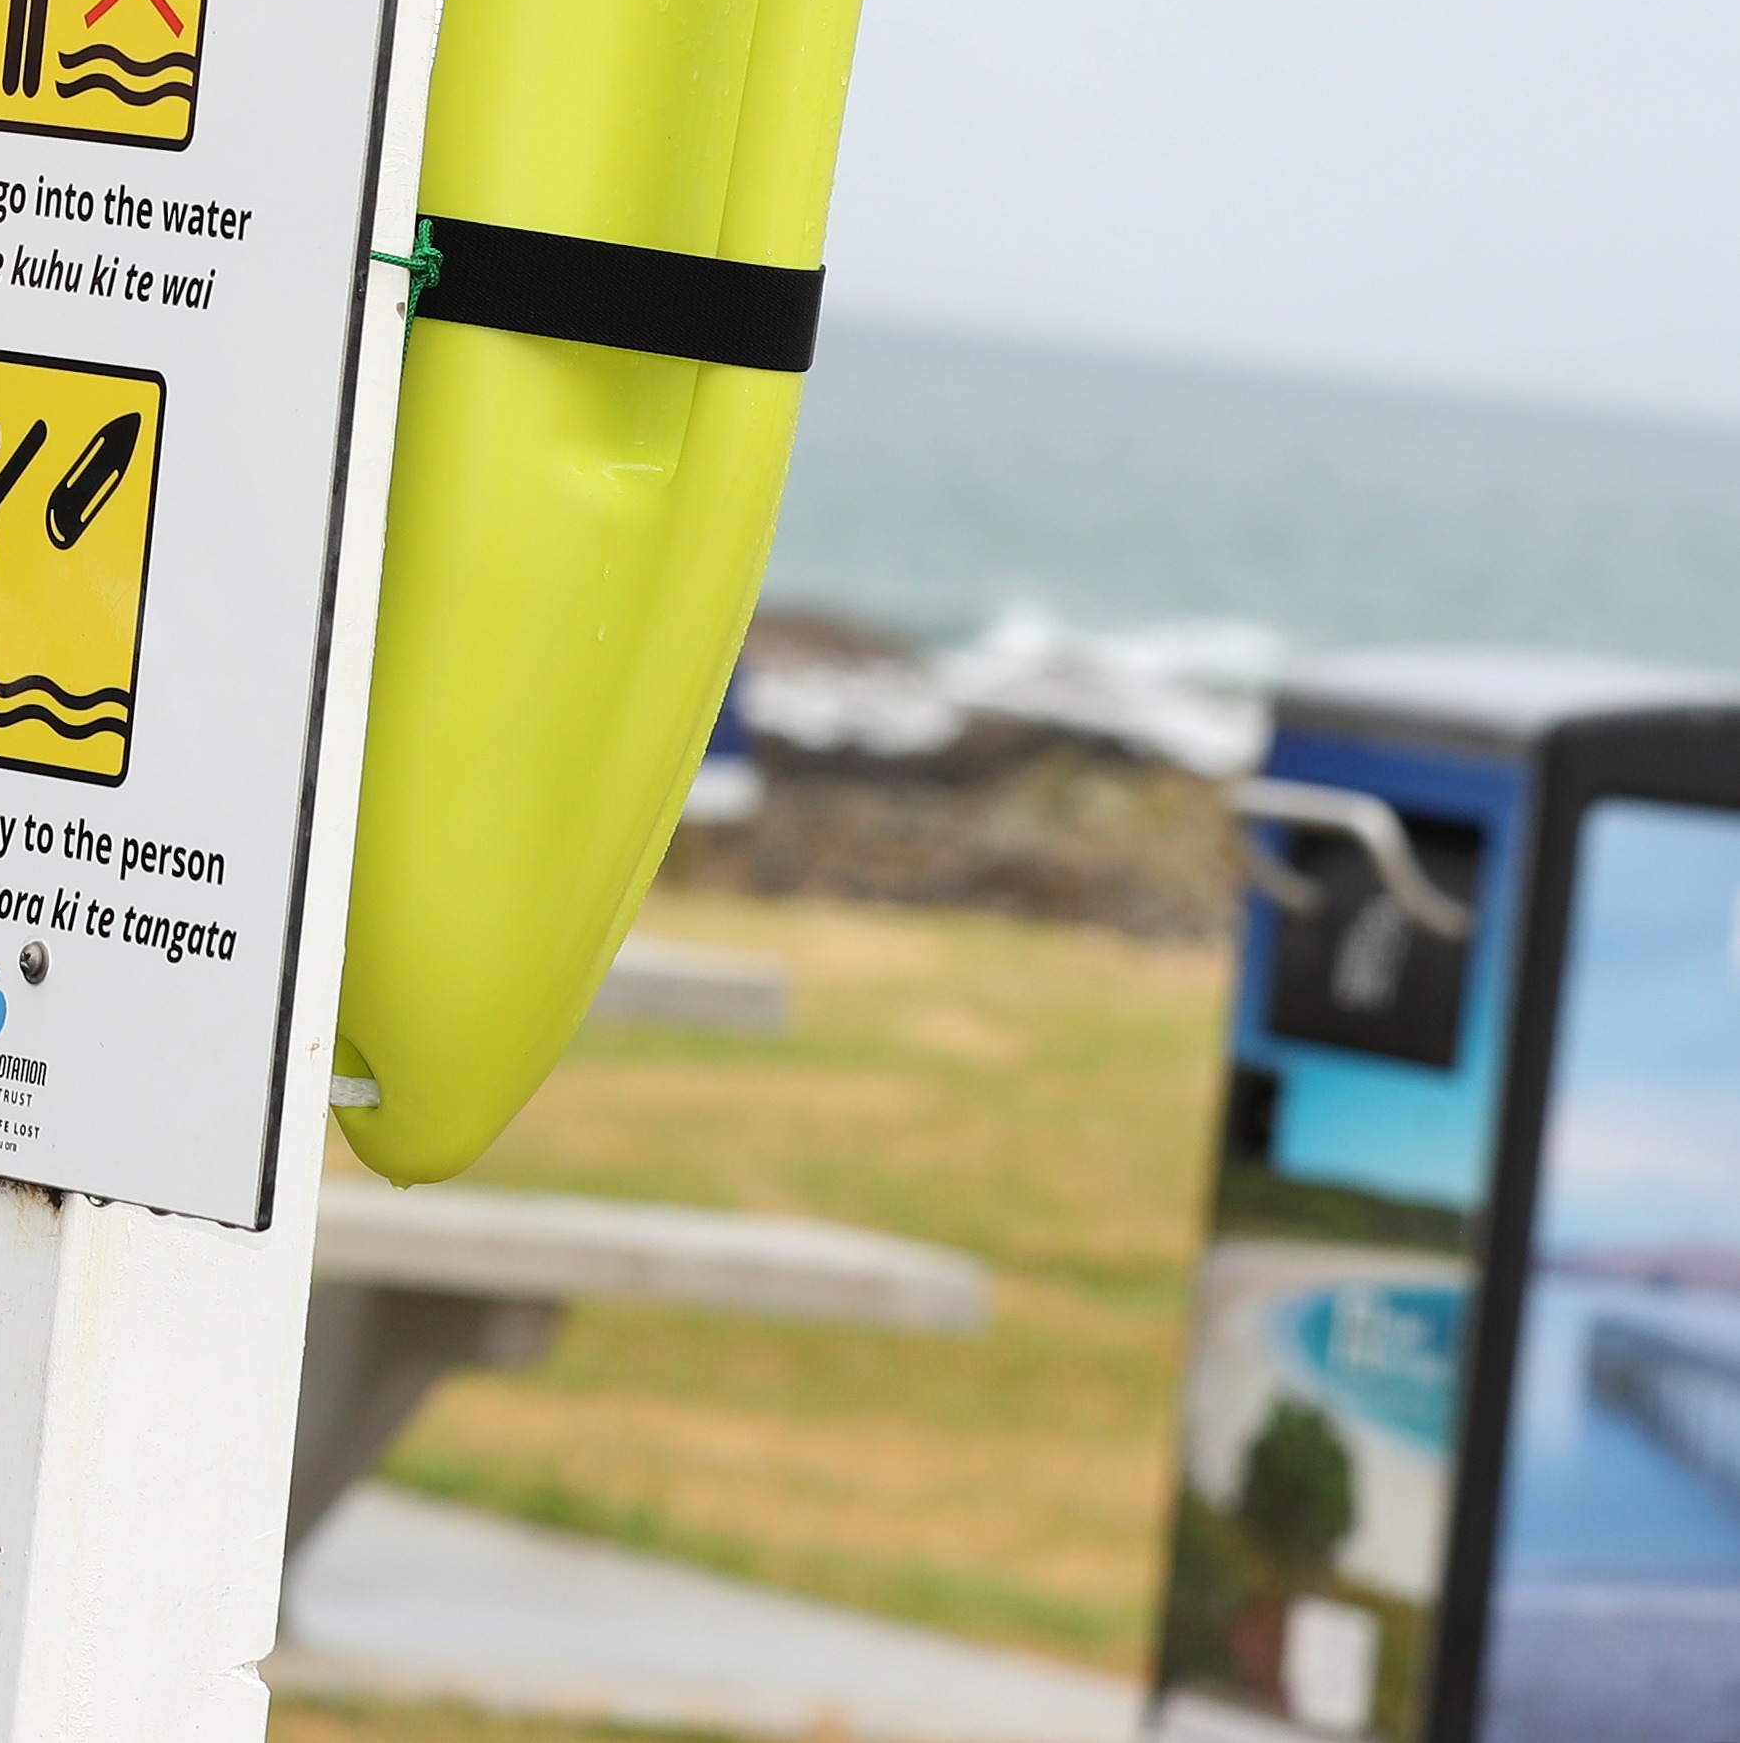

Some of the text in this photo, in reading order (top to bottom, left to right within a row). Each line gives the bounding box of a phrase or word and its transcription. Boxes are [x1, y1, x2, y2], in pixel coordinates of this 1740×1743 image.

[35, 174, 94, 223] into
[103, 184, 153, 230] the
[162, 200, 253, 241] water
[10, 244, 84, 293] kuhu
[88, 254, 120, 298] ki
[124, 263, 154, 303] te
[162, 268, 216, 310] wai
[24, 814, 54, 854] to
[63, 818, 113, 865] the
[119, 837, 225, 886] person
[50, 887, 81, 932] ki
[85, 899, 115, 939] te
[122, 905, 238, 964] tangata
[13, 1122, 40, 1139] LOST
